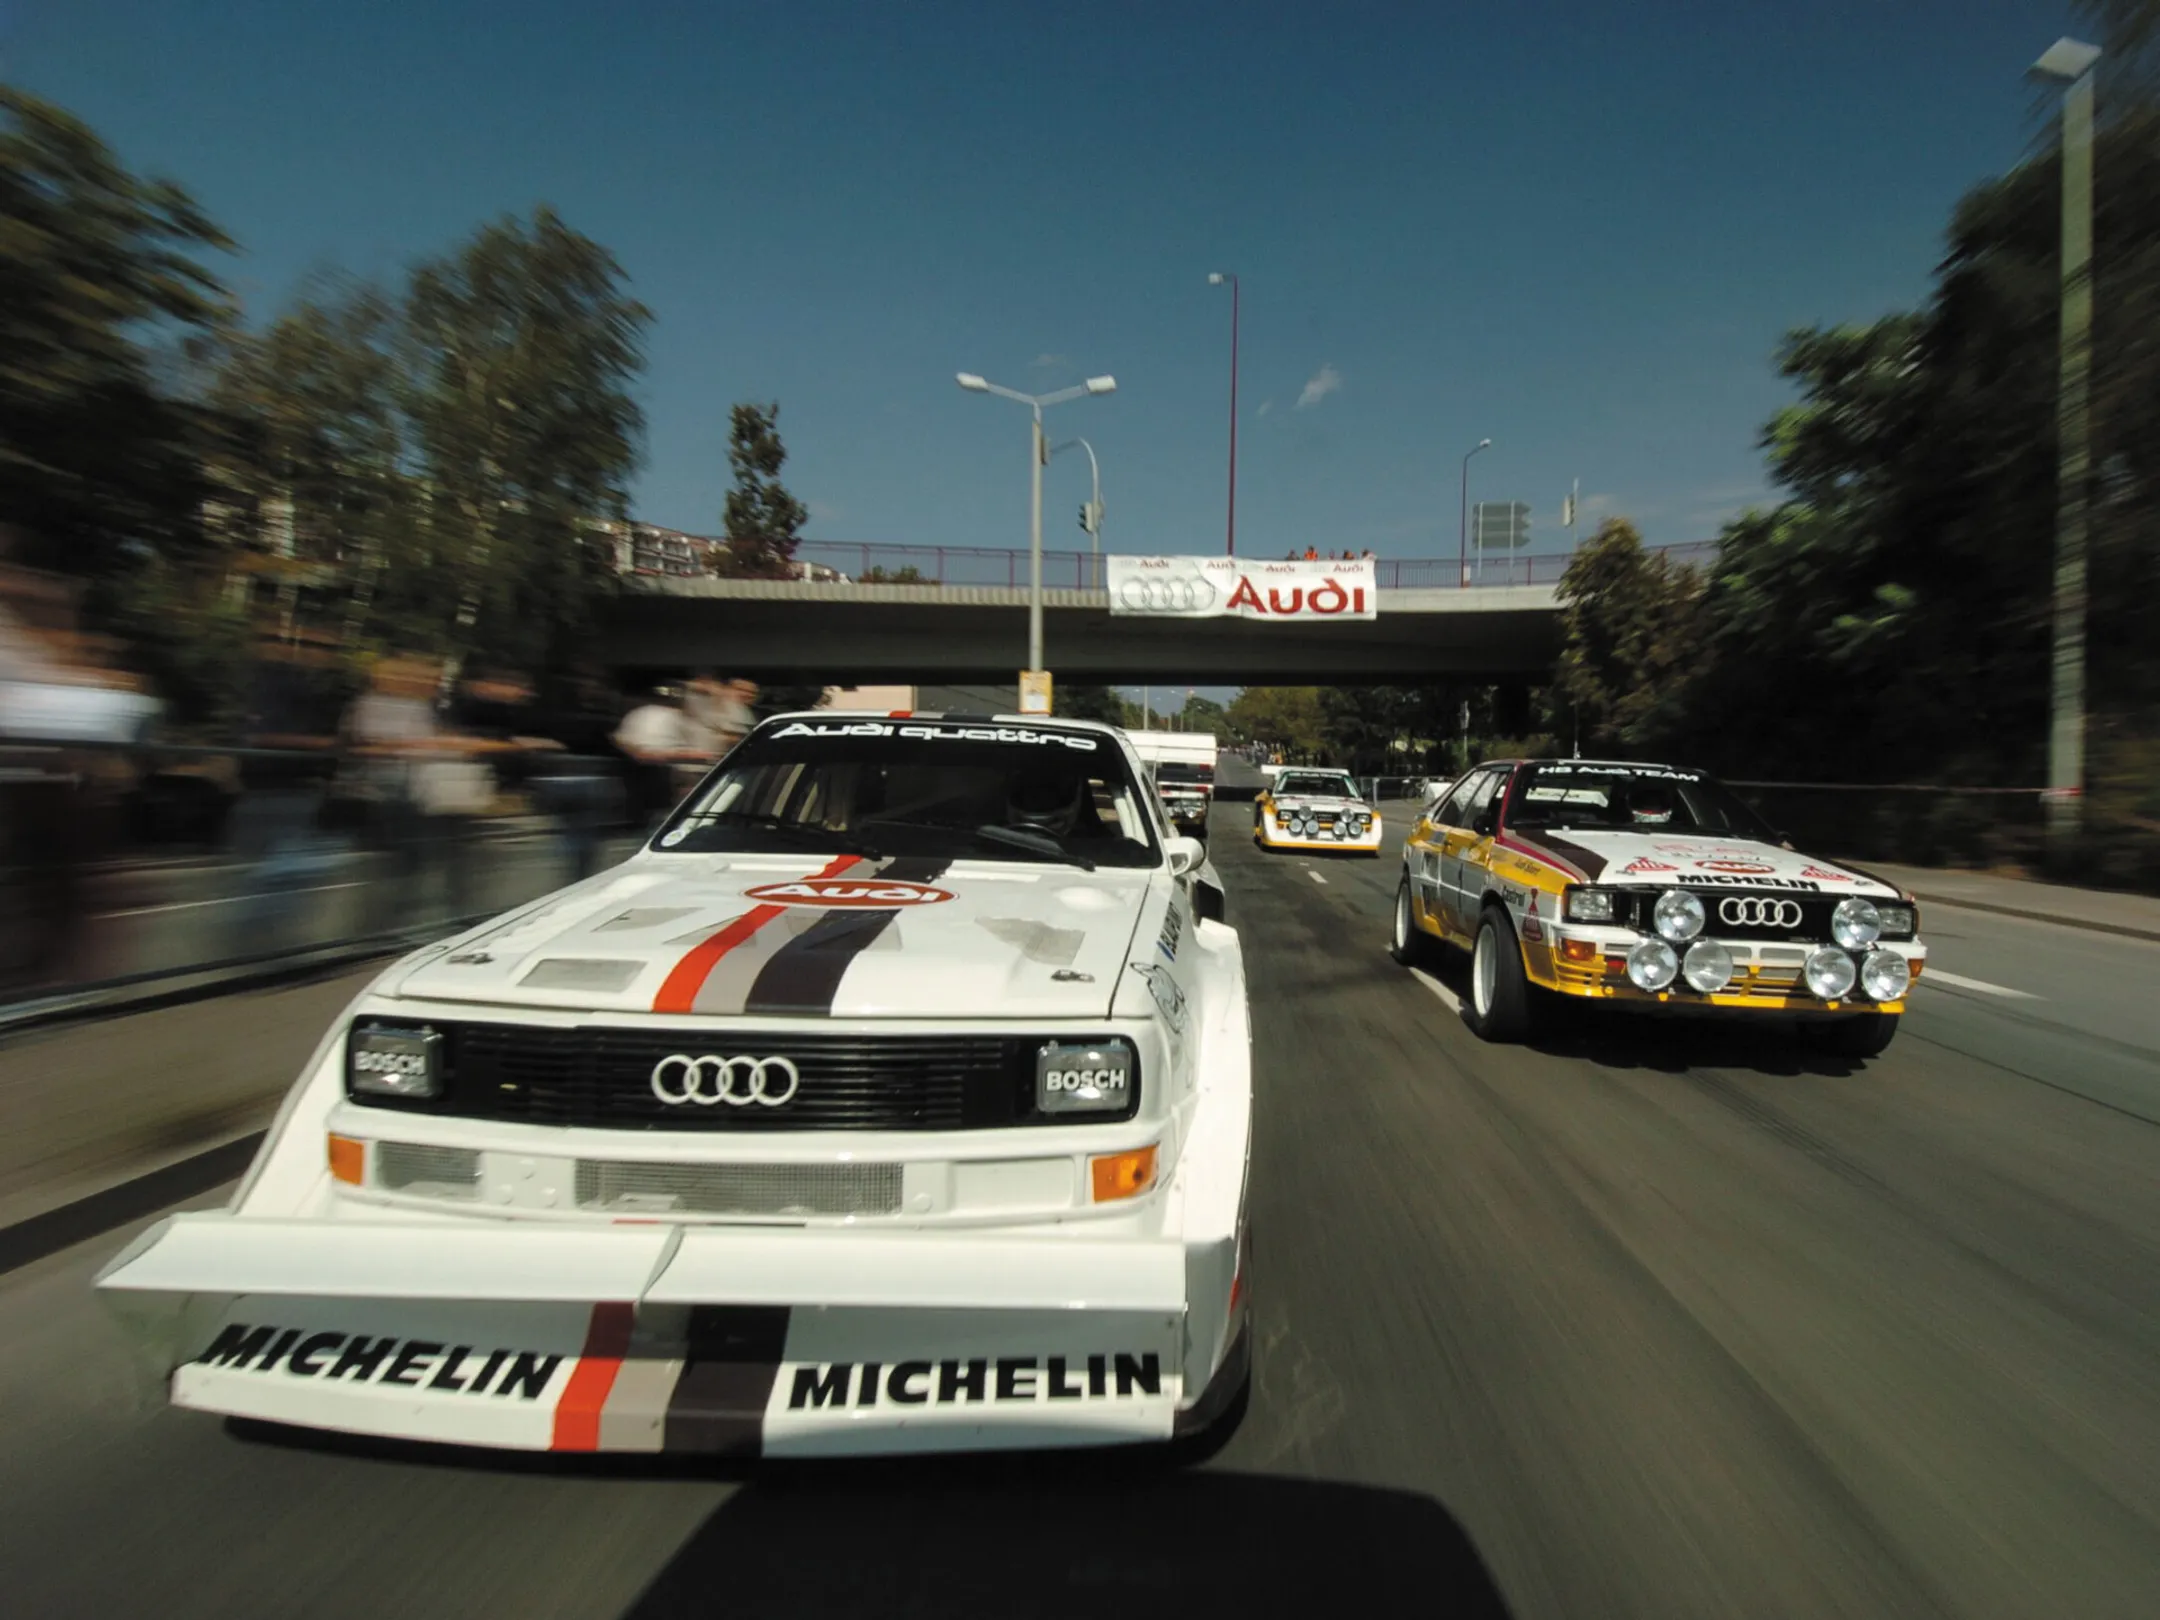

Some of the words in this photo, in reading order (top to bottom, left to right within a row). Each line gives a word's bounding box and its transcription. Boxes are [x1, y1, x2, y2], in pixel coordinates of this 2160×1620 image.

[1226, 575, 1365, 614] Audi
[770, 723, 894, 739] Audi
[899, 727, 1097, 750] quattro
[1632, 769, 1699, 782] TEAM
[751, 884, 941, 901] Audi
[1676, 874, 1820, 891] MICHELIN
[354, 1051, 426, 1075] BOSCH
[1046, 1069, 1125, 1091] BOSCH
[201, 1323, 566, 1400] MICHELIN
[787, 1352, 1162, 1411] MICHELIN
